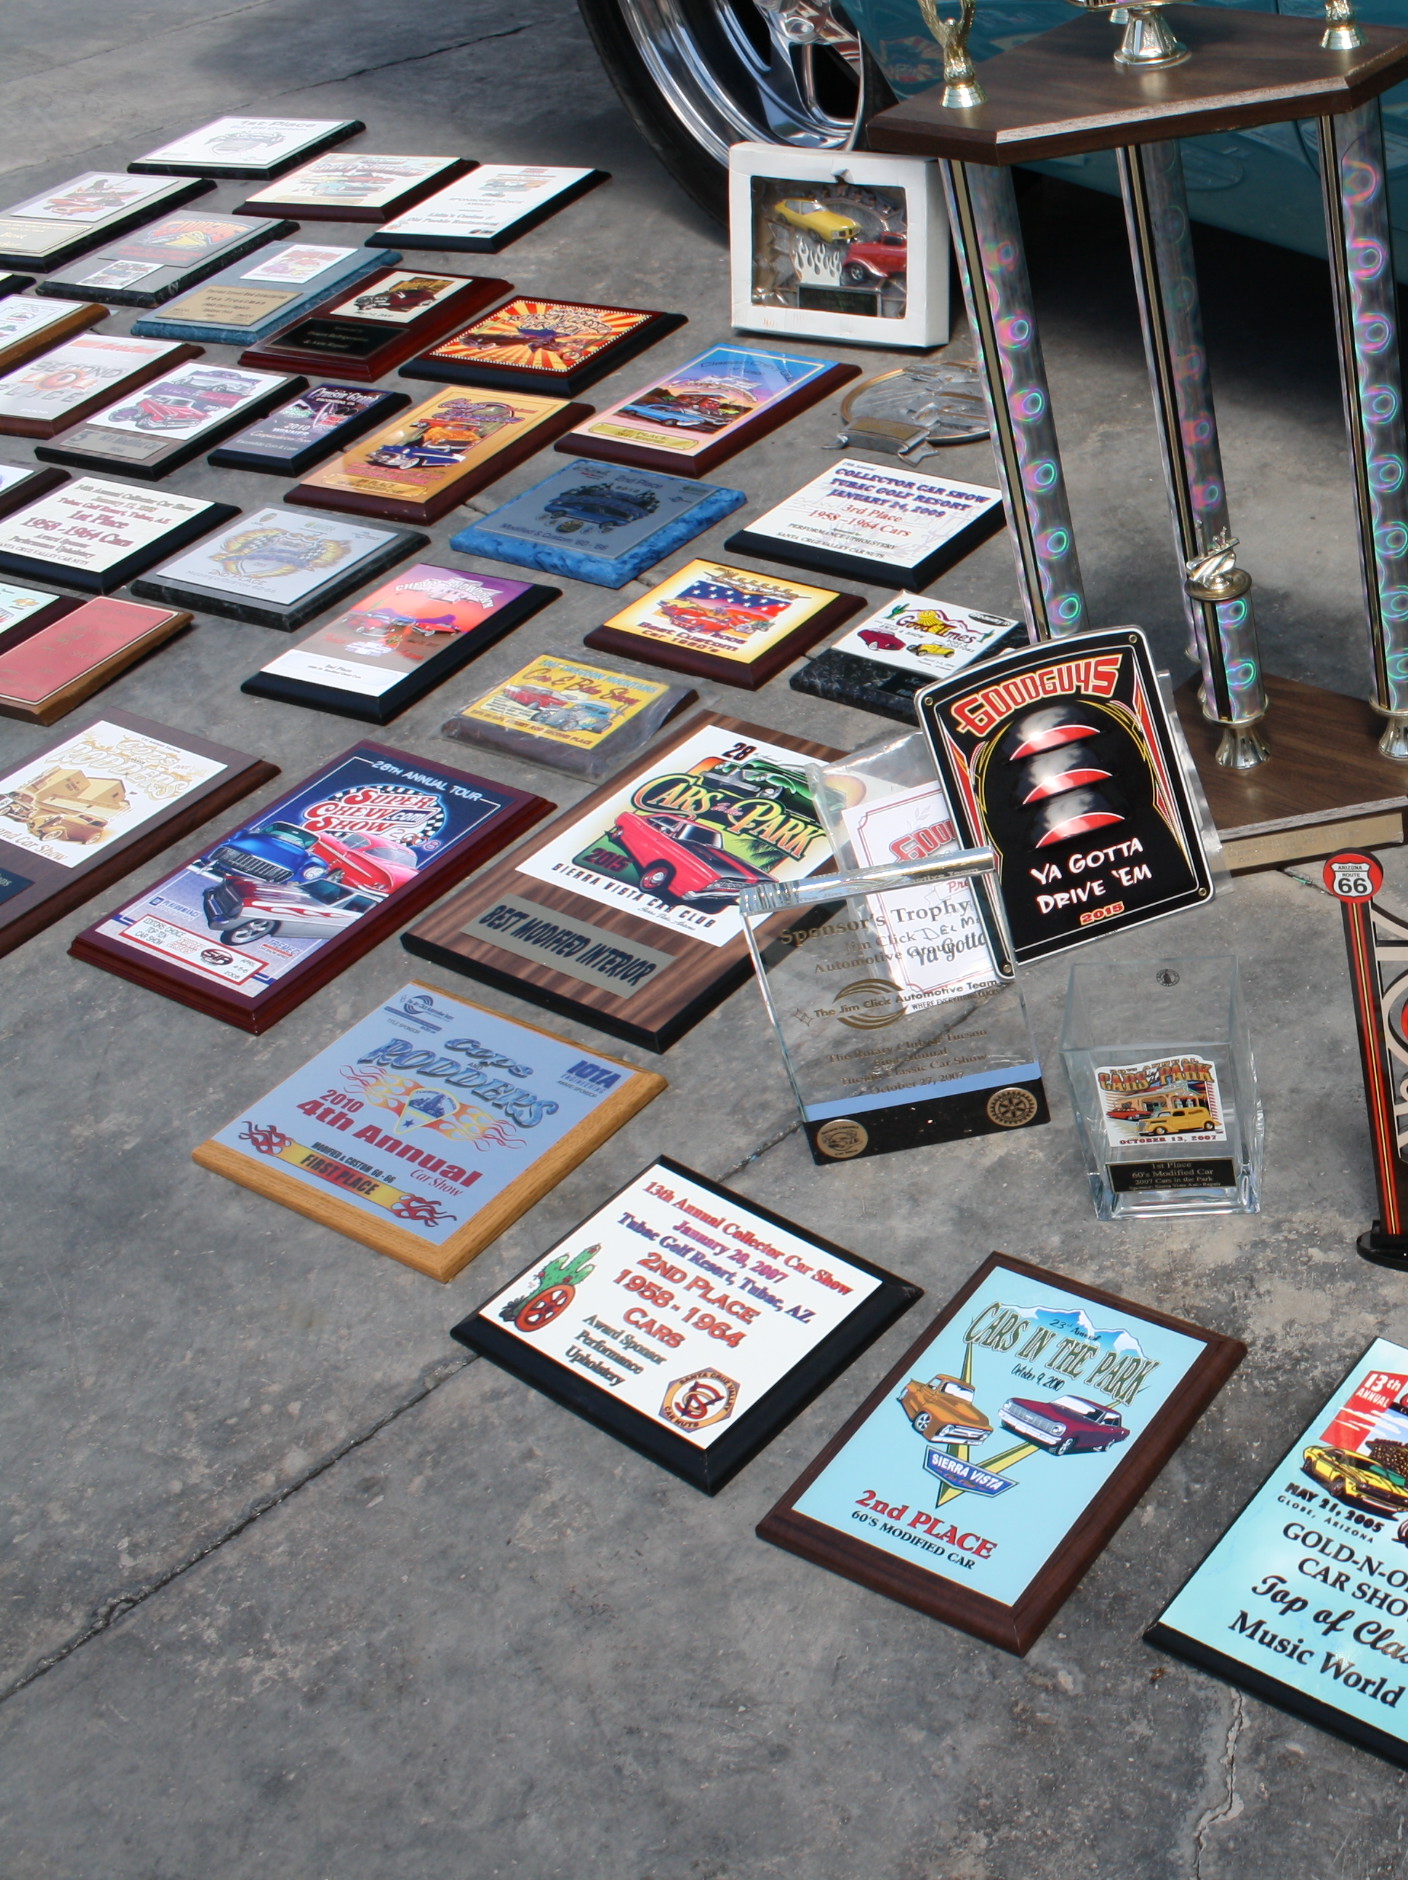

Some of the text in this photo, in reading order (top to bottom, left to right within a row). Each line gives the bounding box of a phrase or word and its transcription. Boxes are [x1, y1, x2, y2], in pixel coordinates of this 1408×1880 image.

[30, 361, 122, 379] SECOND
[284, 422, 311, 431] 2010
[93, 487, 156, 503] Annual Collector
[637, 479, 663, 489] Place
[830, 478, 913, 500] TUBAC GOLF
[919, 484, 991, 504] CAR SHOW
[89, 514, 130, 529] Place
[842, 504, 903, 523] 3rd Place
[501, 523, 573, 543] Modified Custom
[880, 524, 912, 537] Cars
[638, 621, 738, 651] Best Custom
[642, 630, 666, 639] Car
[896, 615, 977, 644] Good Times
[523, 668, 552, 683] Car
[551, 675, 564, 686] &
[600, 687, 641, 705] Show
[951, 654, 1124, 738] GOODGUYS
[372, 761, 484, 801] 28TH ANNUAL TOUR
[19, 836, 68, 862] Car Show
[1029, 837, 1144, 886] YA GOTTA
[1035, 879, 1106, 915] DRIVE
[1338, 878, 1368, 893] 66
[676, 908, 715, 929] CLUB
[892, 899, 970, 927] Trophy
[1080, 901, 1125, 926] 2015
[135, 930, 163, 946] CAR SHOW
[165, 926, 184, 938] CHOICE
[510, 914, 656, 986] MODIFIED INTERIOR
[814, 978, 998, 1018] The Jim Click Team
[444, 1038, 534, 1078] Cops
[356, 1037, 560, 1130] RODDERS
[561, 1073, 610, 1094] ENGINEERING
[566, 1059, 622, 1088] IOTA
[1119, 1137, 1166, 1145] OCTOBER
[352, 1124, 484, 1188] Annual
[334, 1168, 380, 1196] PLACE
[409, 1169, 431, 1184] Car
[635, 1251, 760, 1325] 2ND PLACE
[810, 1267, 855, 1297] Show
[611, 1267, 748, 1349] 1958 1964
[621, 1307, 686, 1351] CARS
[963, 1302, 1160, 1407] CARS THE PARK
[679, 1371, 730, 1386] SANTA CRUZ
[675, 1417, 700, 1428] NUTS
[854, 1488, 999, 1562] 2nd PLACE
[879, 1519, 976, 1571] MODIFIED CAR
[1297, 1557, 1348, 1593] CAR
[1251, 1574, 1311, 1616] Top
[1313, 1605, 1357, 1636] of
[1228, 1610, 1406, 1709] Music World
